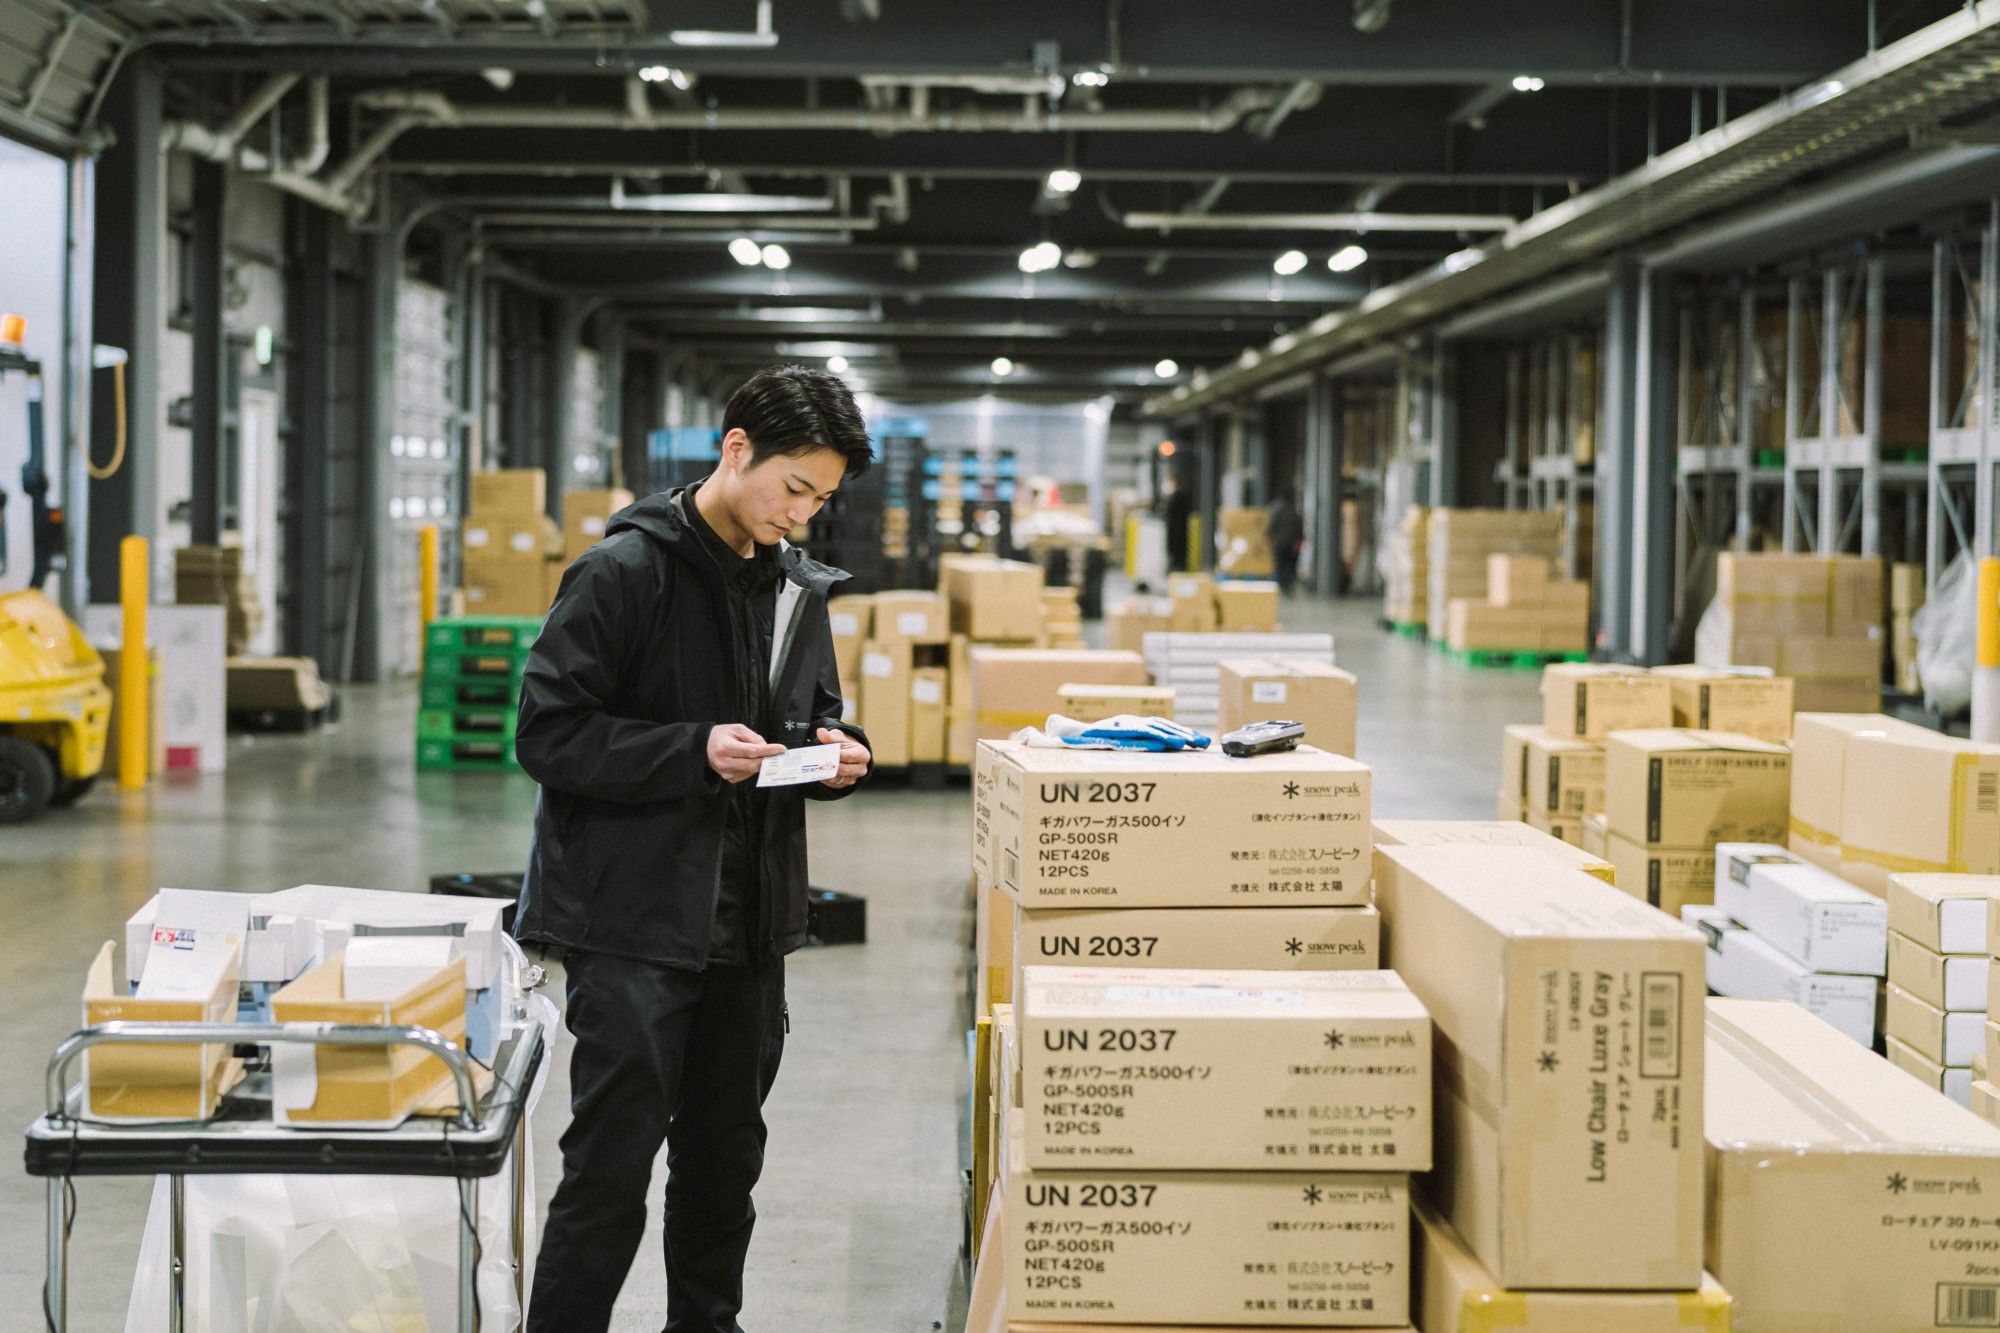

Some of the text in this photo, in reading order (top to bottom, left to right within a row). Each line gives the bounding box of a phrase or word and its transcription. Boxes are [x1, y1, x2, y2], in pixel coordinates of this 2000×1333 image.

[1041, 783, 1079, 803] UN
[1088, 783, 1156, 803] 2037
[1303, 782, 1360, 797] snow peak
[1040, 815, 1185, 828] ギガパワーガス500イソ
[1039, 833, 1118, 844] GP-500SR
[1039, 849, 1109, 862] NET420g
[1040, 866, 1089, 877] 12PCS
[1038, 887, 1118, 896] MADE IN KOREA
[1041, 936, 1158, 957] UN 2037
[1307, 940, 1365, 954] snow peak
[1044, 1029, 1176, 1051] UN 2037
[1587, 971, 1614, 1182] Low Chair Luxe Gray
[1043, 1084, 1133, 1098] GP-500SR
[1044, 1103, 1124, 1118] NET420g
[1045, 1121, 1101, 1135] 12PCS
[1026, 1184, 1157, 1207] UN 2037
[1025, 1239, 1114, 1253] GP-500SR
[1025, 1258, 1104, 1272] NET420g
[1026, 1276, 1081, 1289] 12PCS
[1075, 1301, 1114, 1309] KOREA
